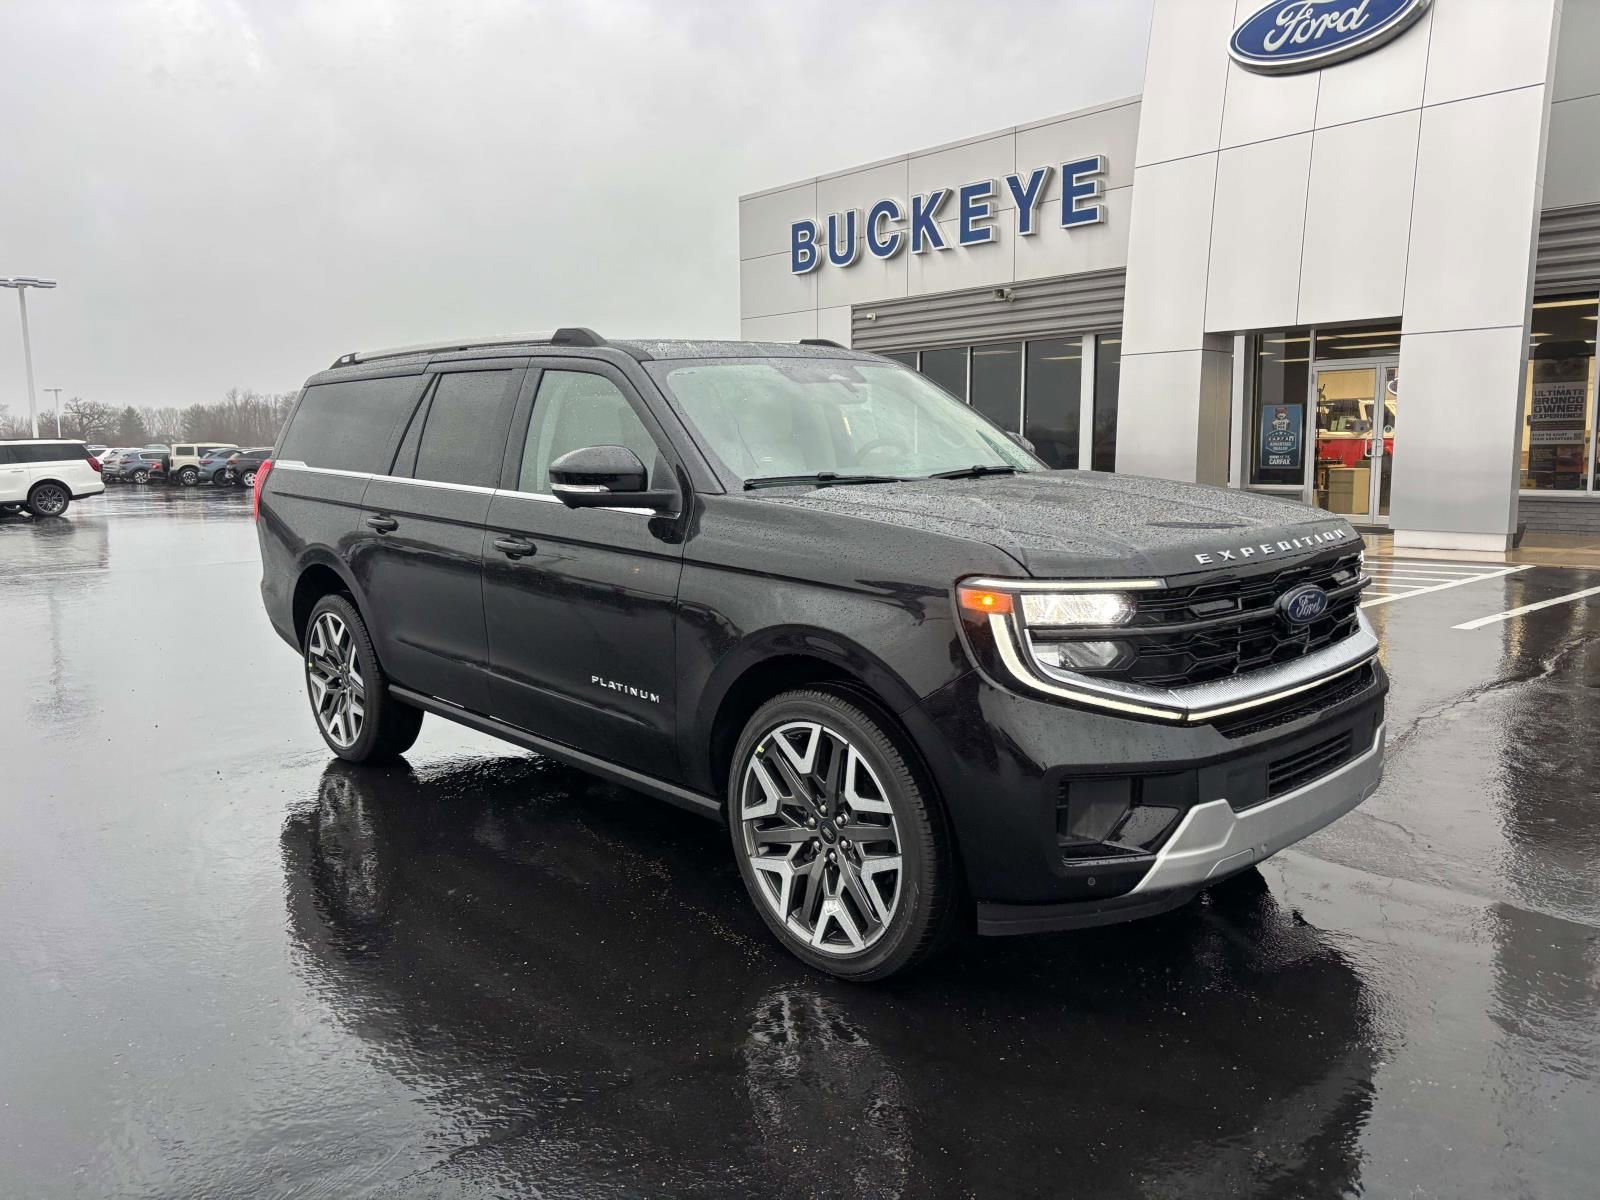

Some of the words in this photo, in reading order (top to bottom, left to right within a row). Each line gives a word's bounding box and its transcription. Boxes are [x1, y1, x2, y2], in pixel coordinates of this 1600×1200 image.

[1263, 0, 1370, 51] Ford
[790, 154, 1106, 275] BUCKEYE
[1534, 389, 1585, 397] ULTIMATE
[1534, 396, 1584, 405] BRONCO
[1533, 404, 1583, 413] OWNER
[1533, 412, 1584, 420] EXPERIENCE
[1195, 528, 1347, 565] EXPEDITION
[1296, 593, 1321, 618] Ford
[591, 675, 660, 704] PLATINUM
